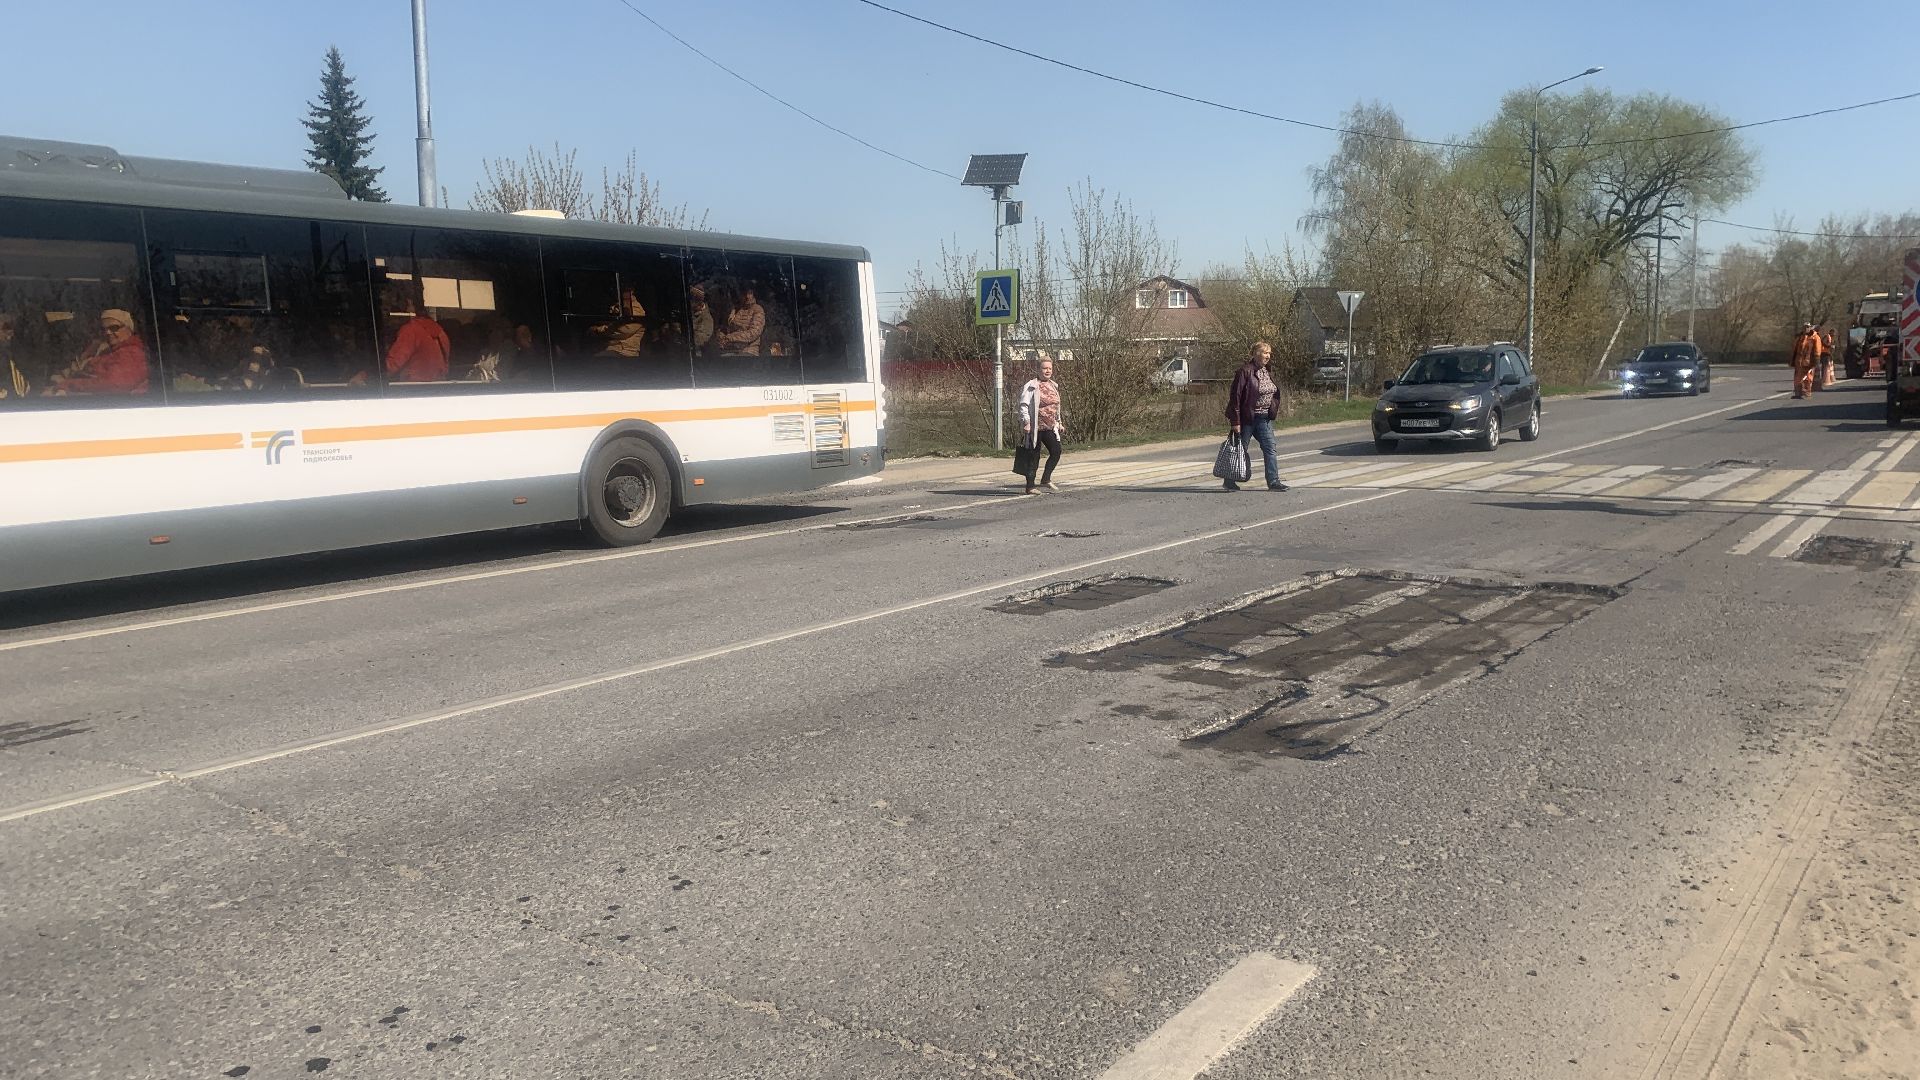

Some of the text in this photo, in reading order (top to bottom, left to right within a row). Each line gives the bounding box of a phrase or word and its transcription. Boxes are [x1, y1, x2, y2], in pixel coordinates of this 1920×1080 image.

[764, 389, 793, 400] 031002
[303, 448, 340, 456] ТРАНСПОРТ
[303, 455, 352, 463] ПОДМОСКОВЬЯ
